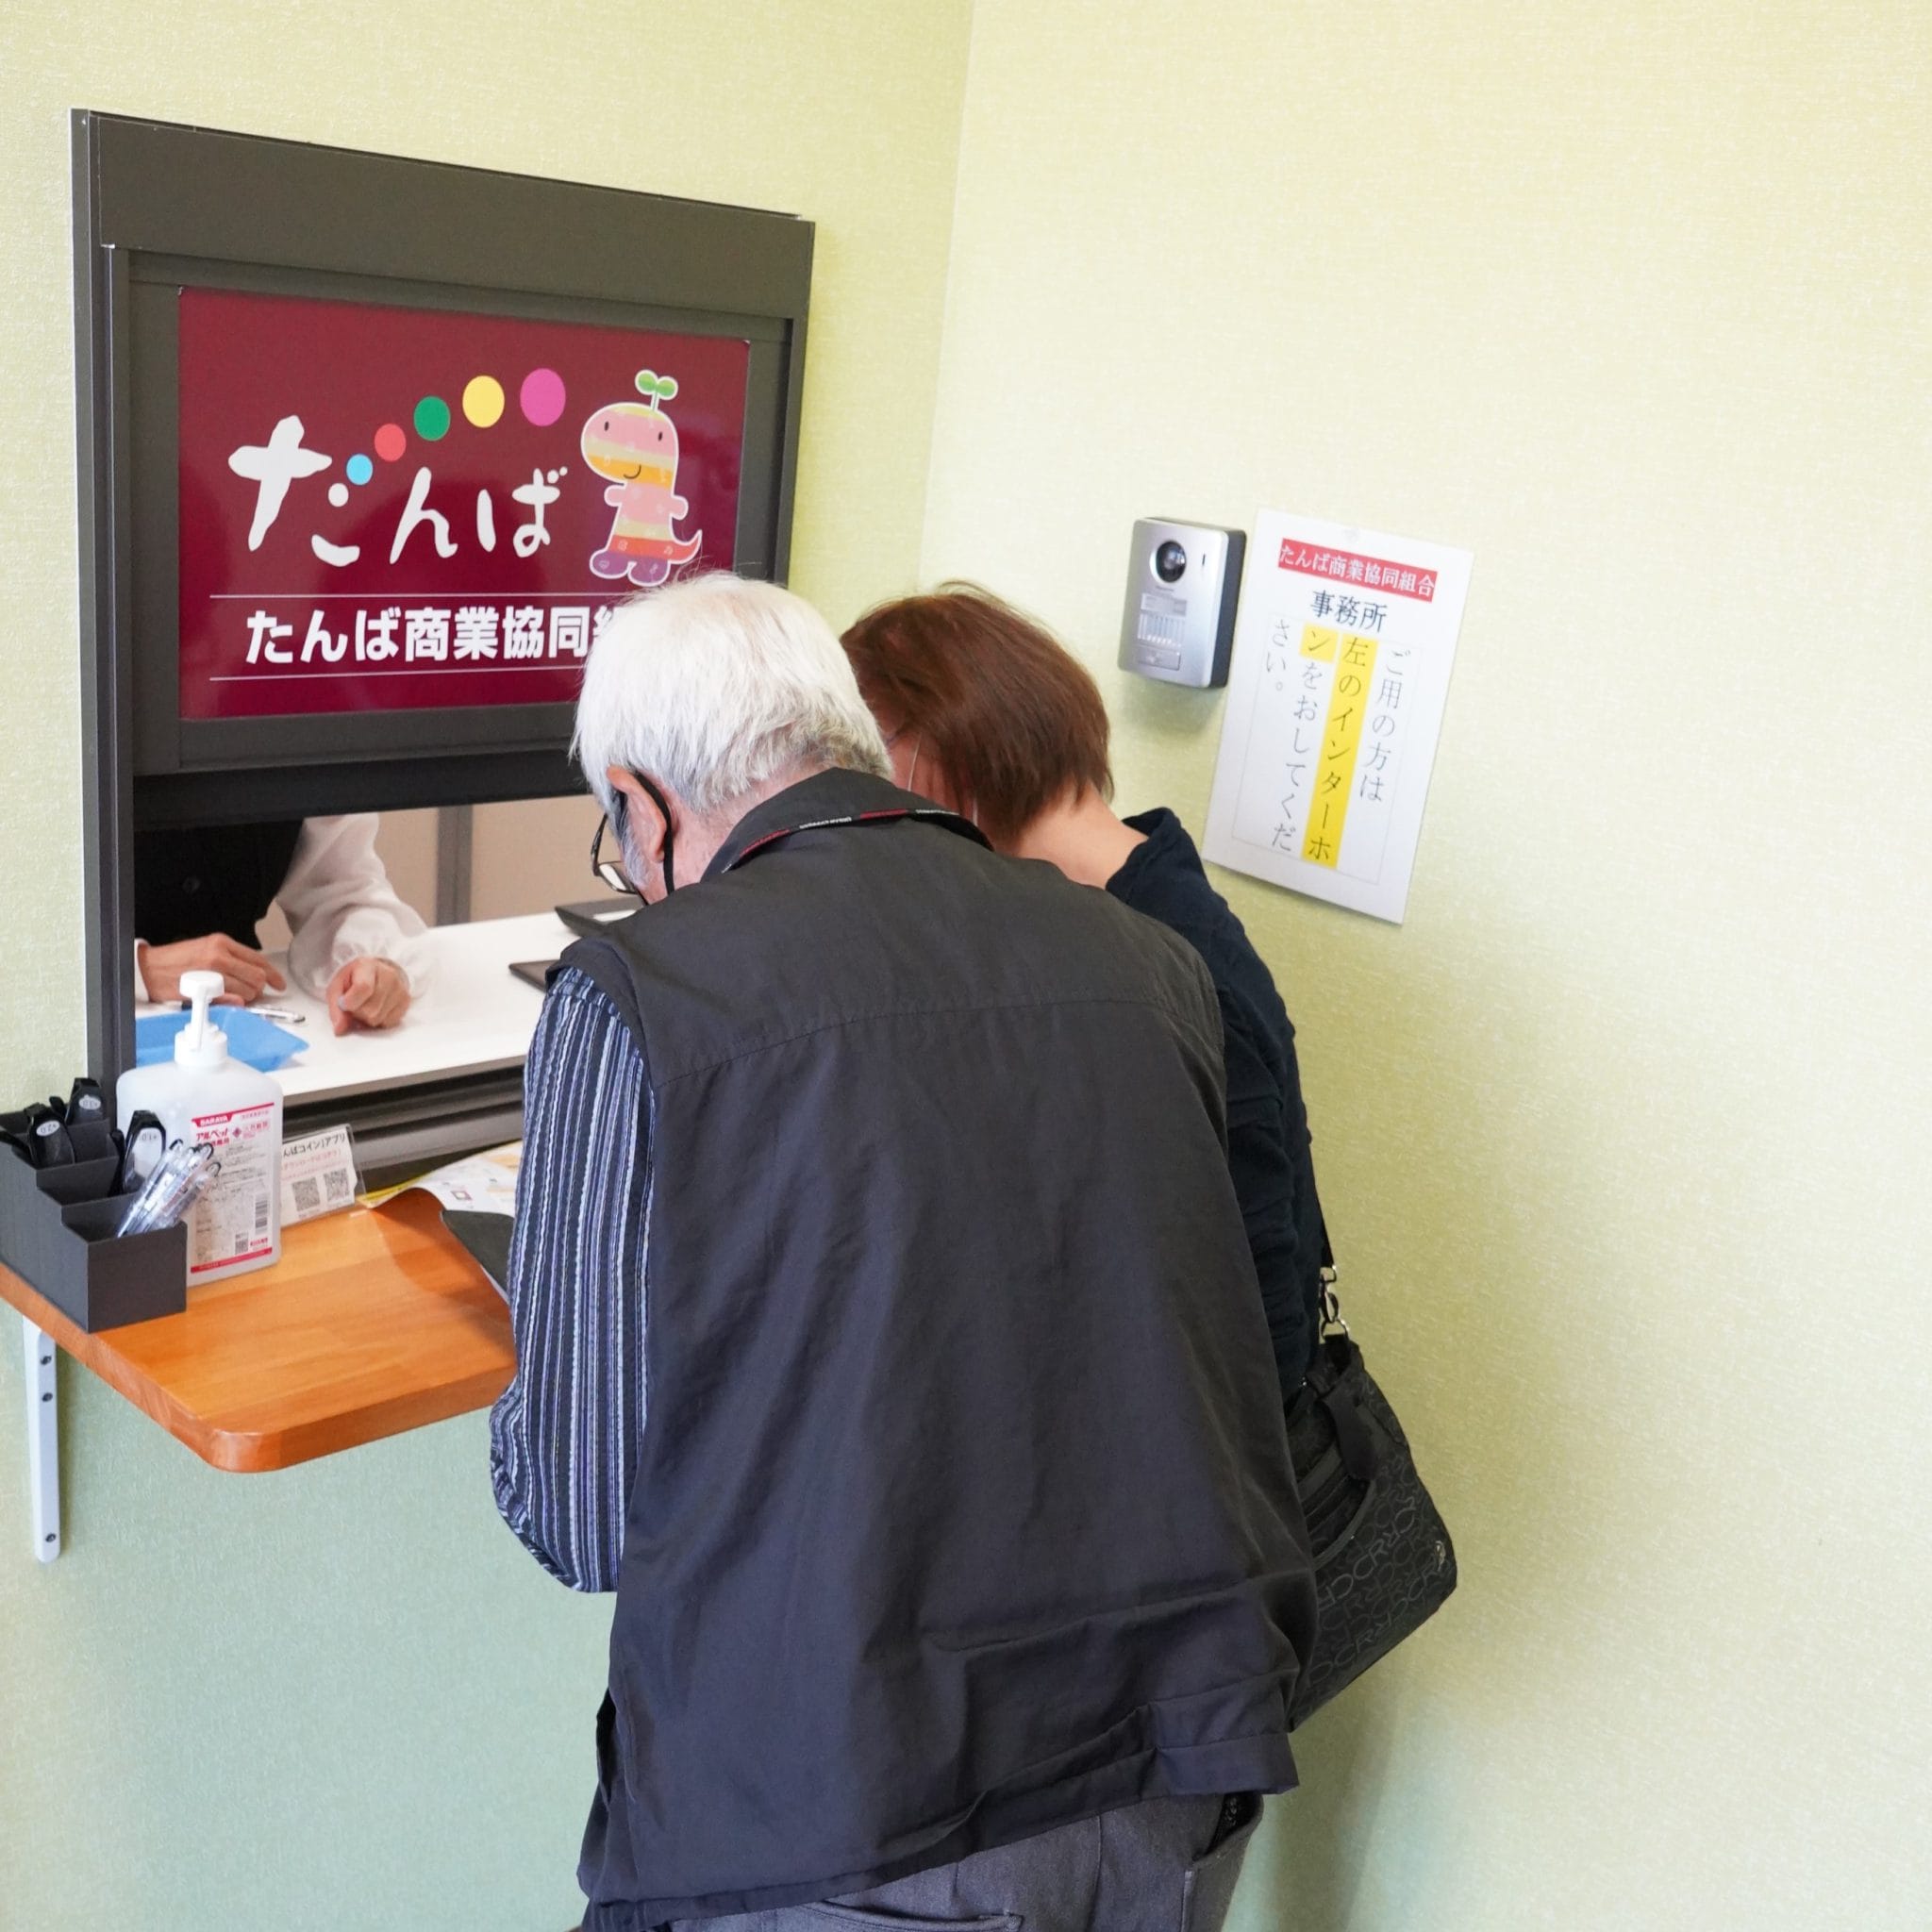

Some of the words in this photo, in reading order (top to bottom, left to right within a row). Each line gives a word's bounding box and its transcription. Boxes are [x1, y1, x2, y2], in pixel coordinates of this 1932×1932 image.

[228, 414, 568, 566] たんば
[1279, 544, 1435, 597] たんば商業協同組合
[1310, 590, 1388, 633] 事務所
[1265, 619, 1291, 692] さい。
[1359, 648, 1410, 803] ご用の方は
[1271, 629, 1332, 853] ンをおしてくだ
[1307, 637, 1370, 861] 左のインターホ
